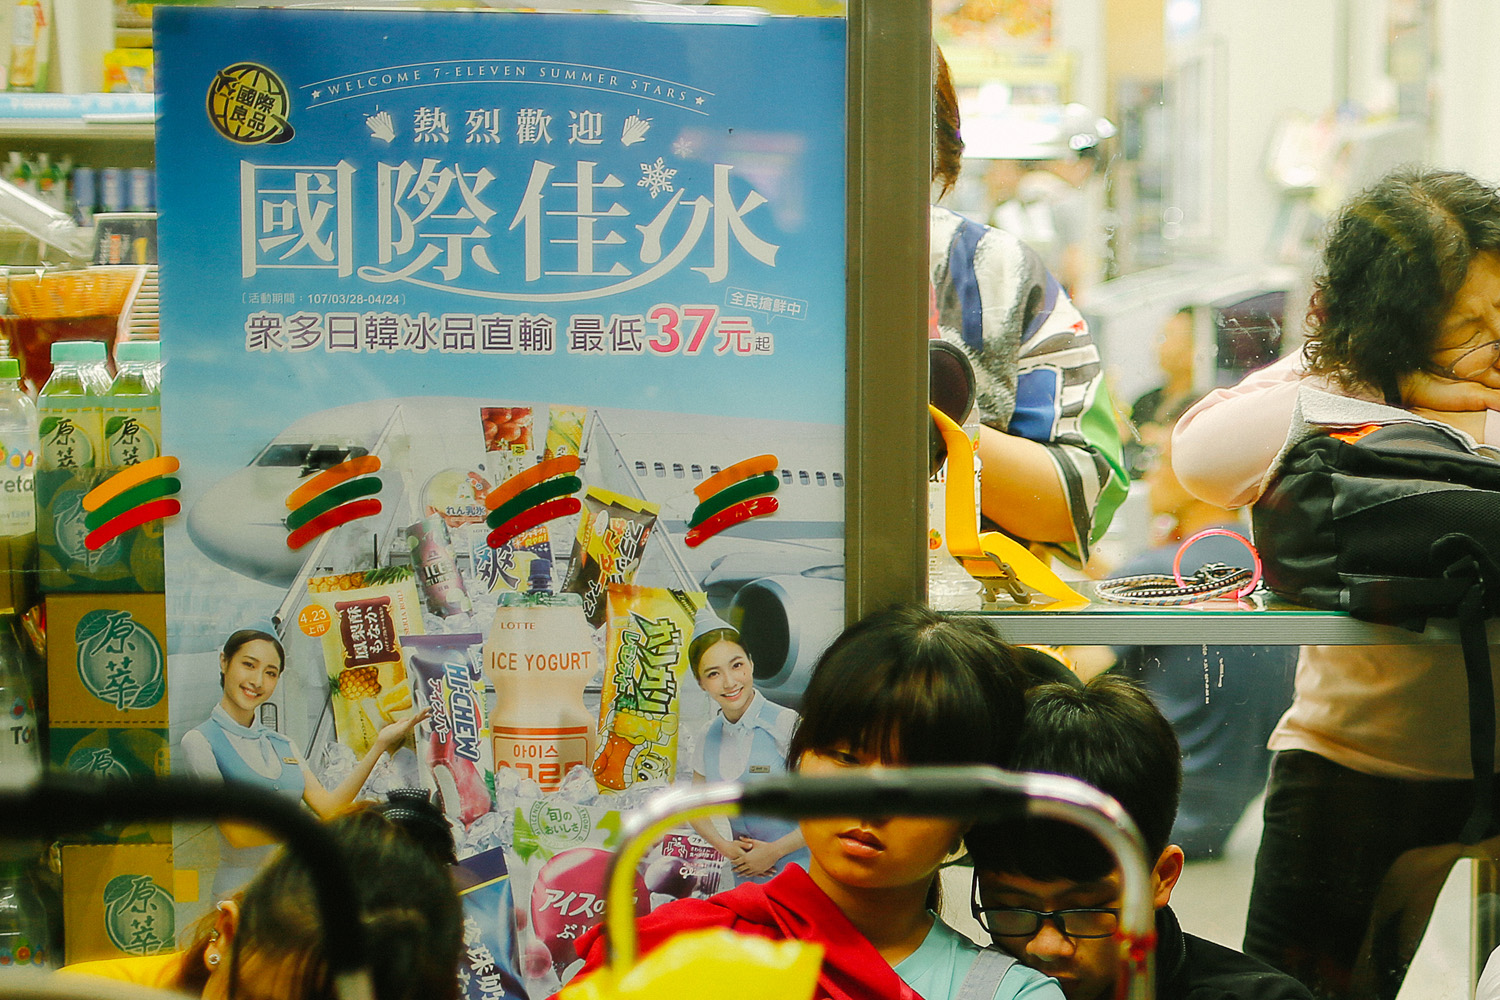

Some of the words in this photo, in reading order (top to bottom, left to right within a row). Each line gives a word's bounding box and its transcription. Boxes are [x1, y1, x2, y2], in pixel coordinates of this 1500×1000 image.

[327, 70, 422, 95] WELCOME
[434, 66, 526, 78] 7-ELEVEN
[539, 67, 618, 86] SUMMER
[631, 79, 687, 101] STARS
[235, 85, 276, 115] 國際
[230, 105, 266, 132] 良品
[413, 106, 605, 145] 熱烈歡迎
[240, 156, 780, 284] 國際佳冰
[731, 291, 802, 316] 全民搶鮮中
[300, 609, 327, 624] 4.23
[501, 622, 536, 630] LOTTE
[308, 624, 325, 635] 上市
[491, 652, 518, 670] ICE
[524, 651, 592, 672] YOGURT
[442, 661, 481, 763] HI-CHEW
[513, 744, 560, 758] 아이스
[547, 808, 573, 822] 旬の
